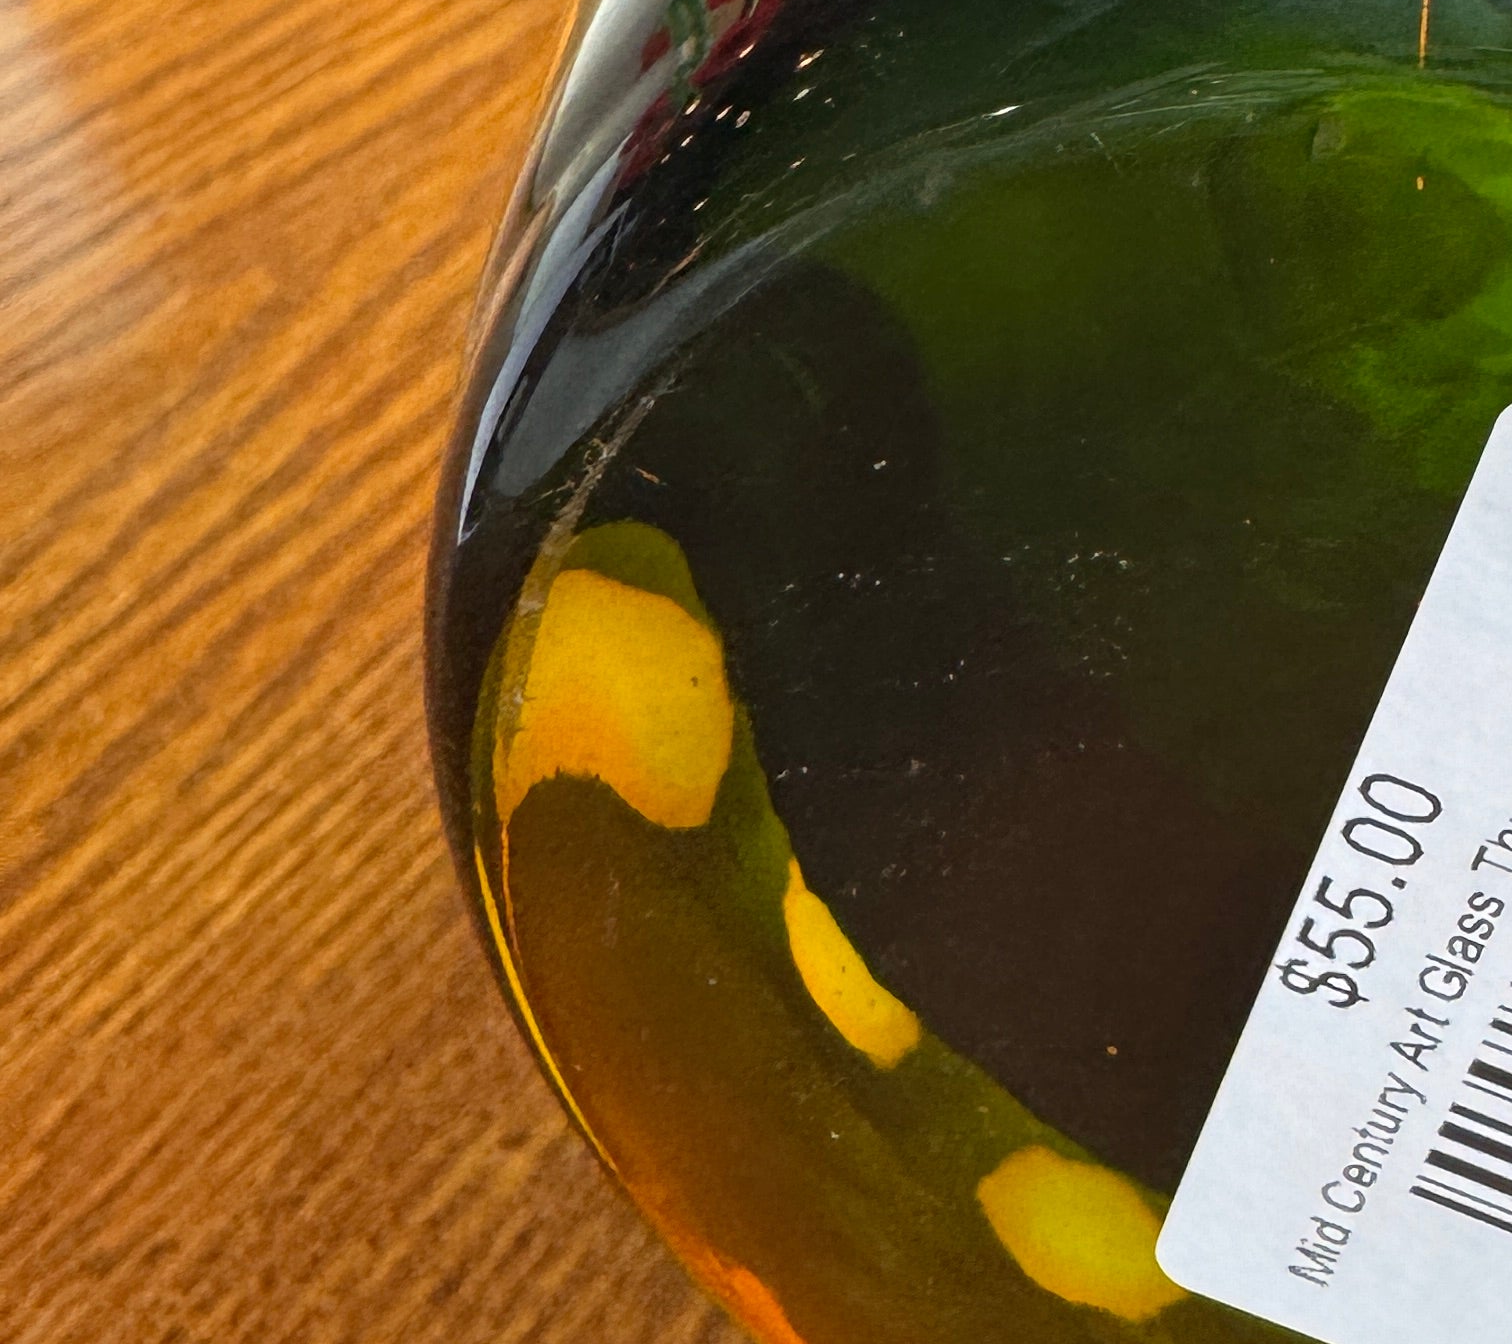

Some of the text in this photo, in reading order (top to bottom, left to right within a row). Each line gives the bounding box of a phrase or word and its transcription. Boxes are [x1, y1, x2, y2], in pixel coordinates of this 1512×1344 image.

[1276, 774, 1442, 1008] $55.00
[1289, 1217, 1351, 1285] Mid
[1322, 1072, 1426, 1212] Century
[1390, 1008, 1449, 1071] Art
[1420, 892, 1504, 1001] Glass
